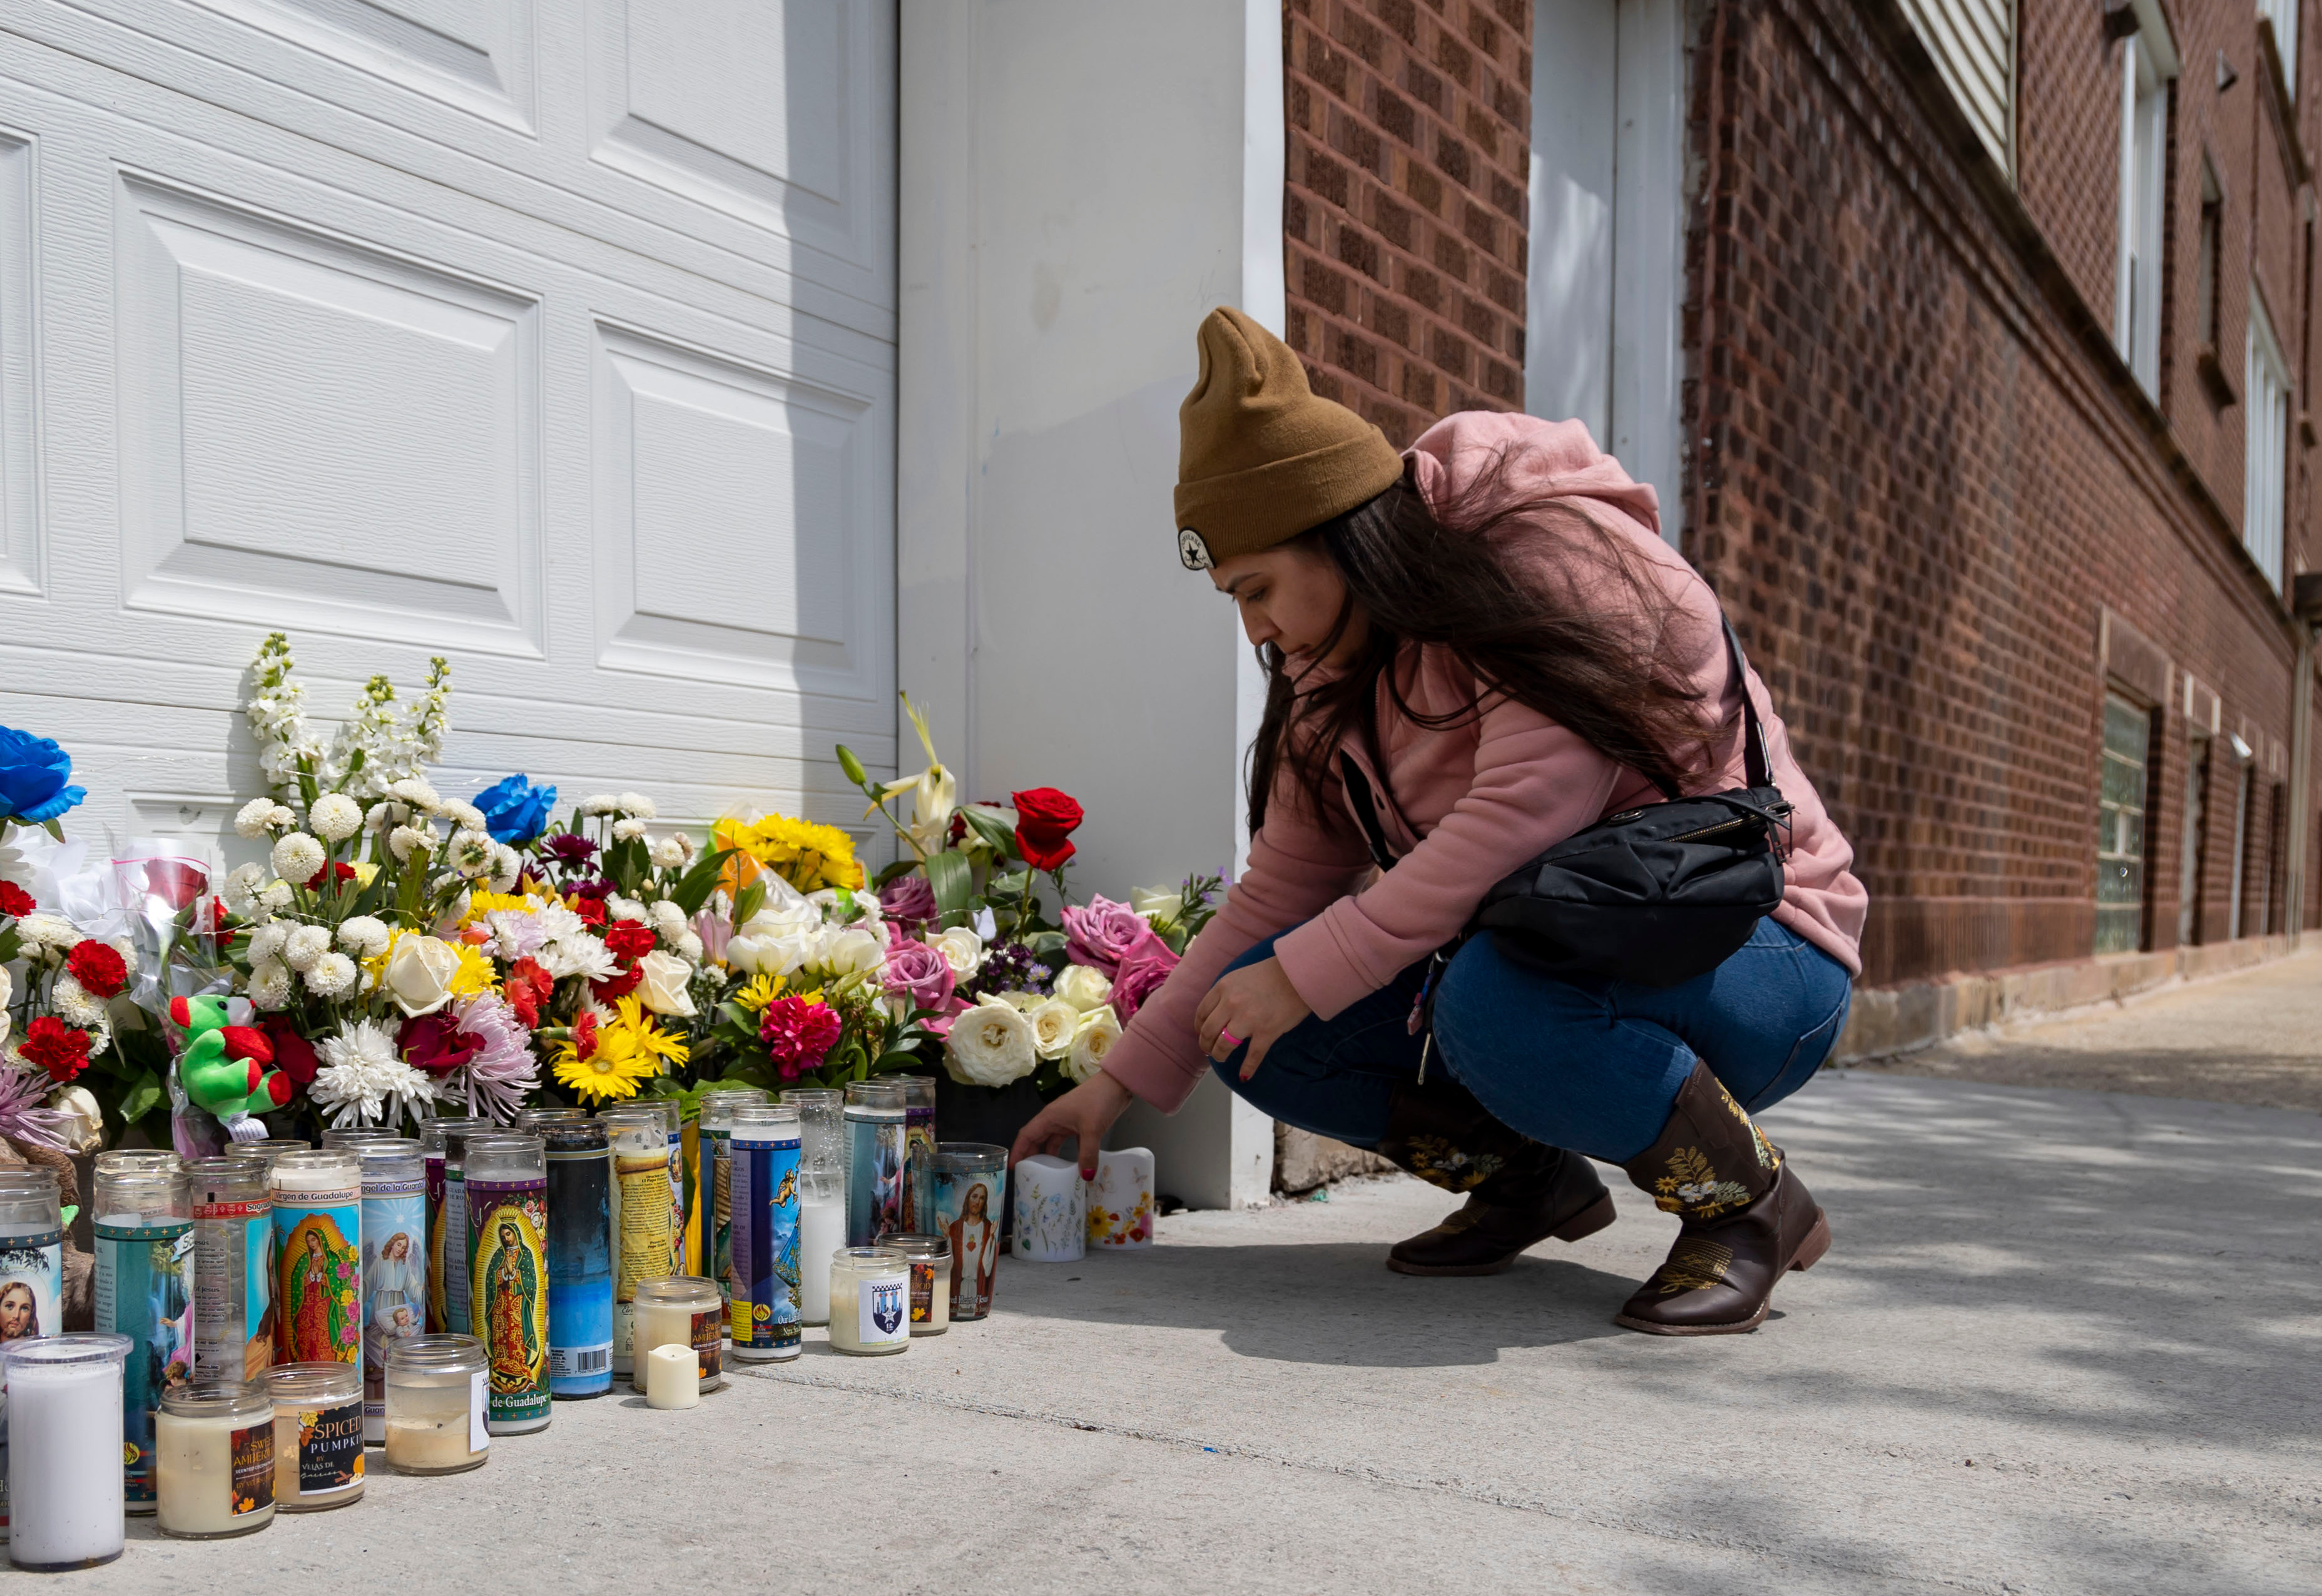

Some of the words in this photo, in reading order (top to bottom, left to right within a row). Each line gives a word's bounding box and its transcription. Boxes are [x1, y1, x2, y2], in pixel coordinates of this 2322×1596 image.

[361, 1184, 378, 1194] ngel
[275, 1193, 296, 1202] Virgen
[311, 1191, 354, 1201] Guadalupe
[959, 1295, 972, 1304] Heart
[778, 1314, 788, 1324] Our
[492, 1396, 502, 1408] de
[506, 1393, 546, 1408] Guadalupe
[315, 1415, 361, 1439] SPICED
[302, 1462, 323, 1471] VELAS
